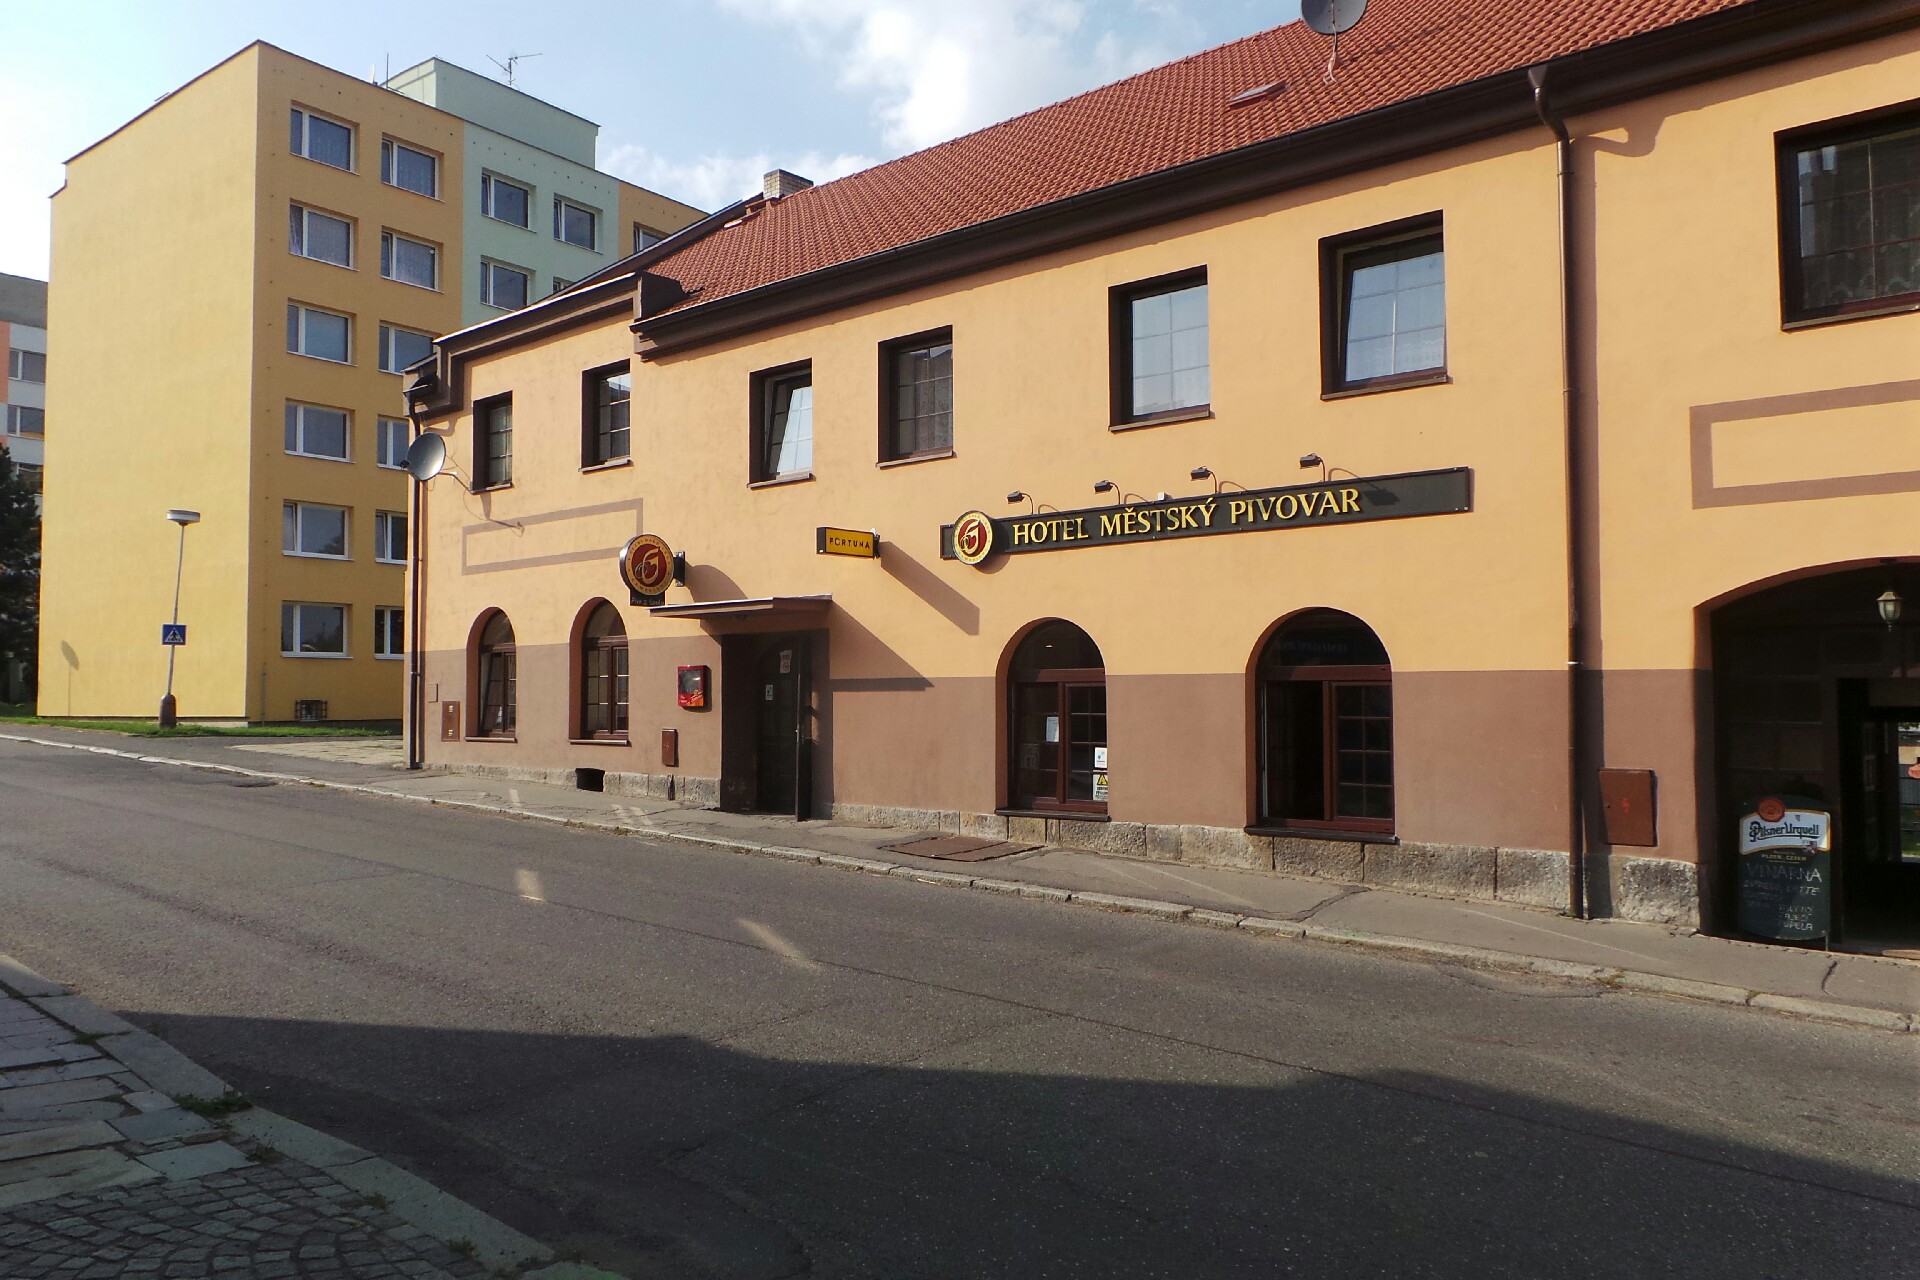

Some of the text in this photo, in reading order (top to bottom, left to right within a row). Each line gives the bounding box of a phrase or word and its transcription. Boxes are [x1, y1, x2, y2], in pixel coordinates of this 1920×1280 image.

[1012, 517, 1089, 545] HOTEL
[1099, 498, 1217, 537] MĚSTSKÝ
[1230, 488, 1361, 524] PIVOVAR
[829, 537, 870, 549] FORTUNA
[1749, 821, 1819, 842] Pilsner Urquell
